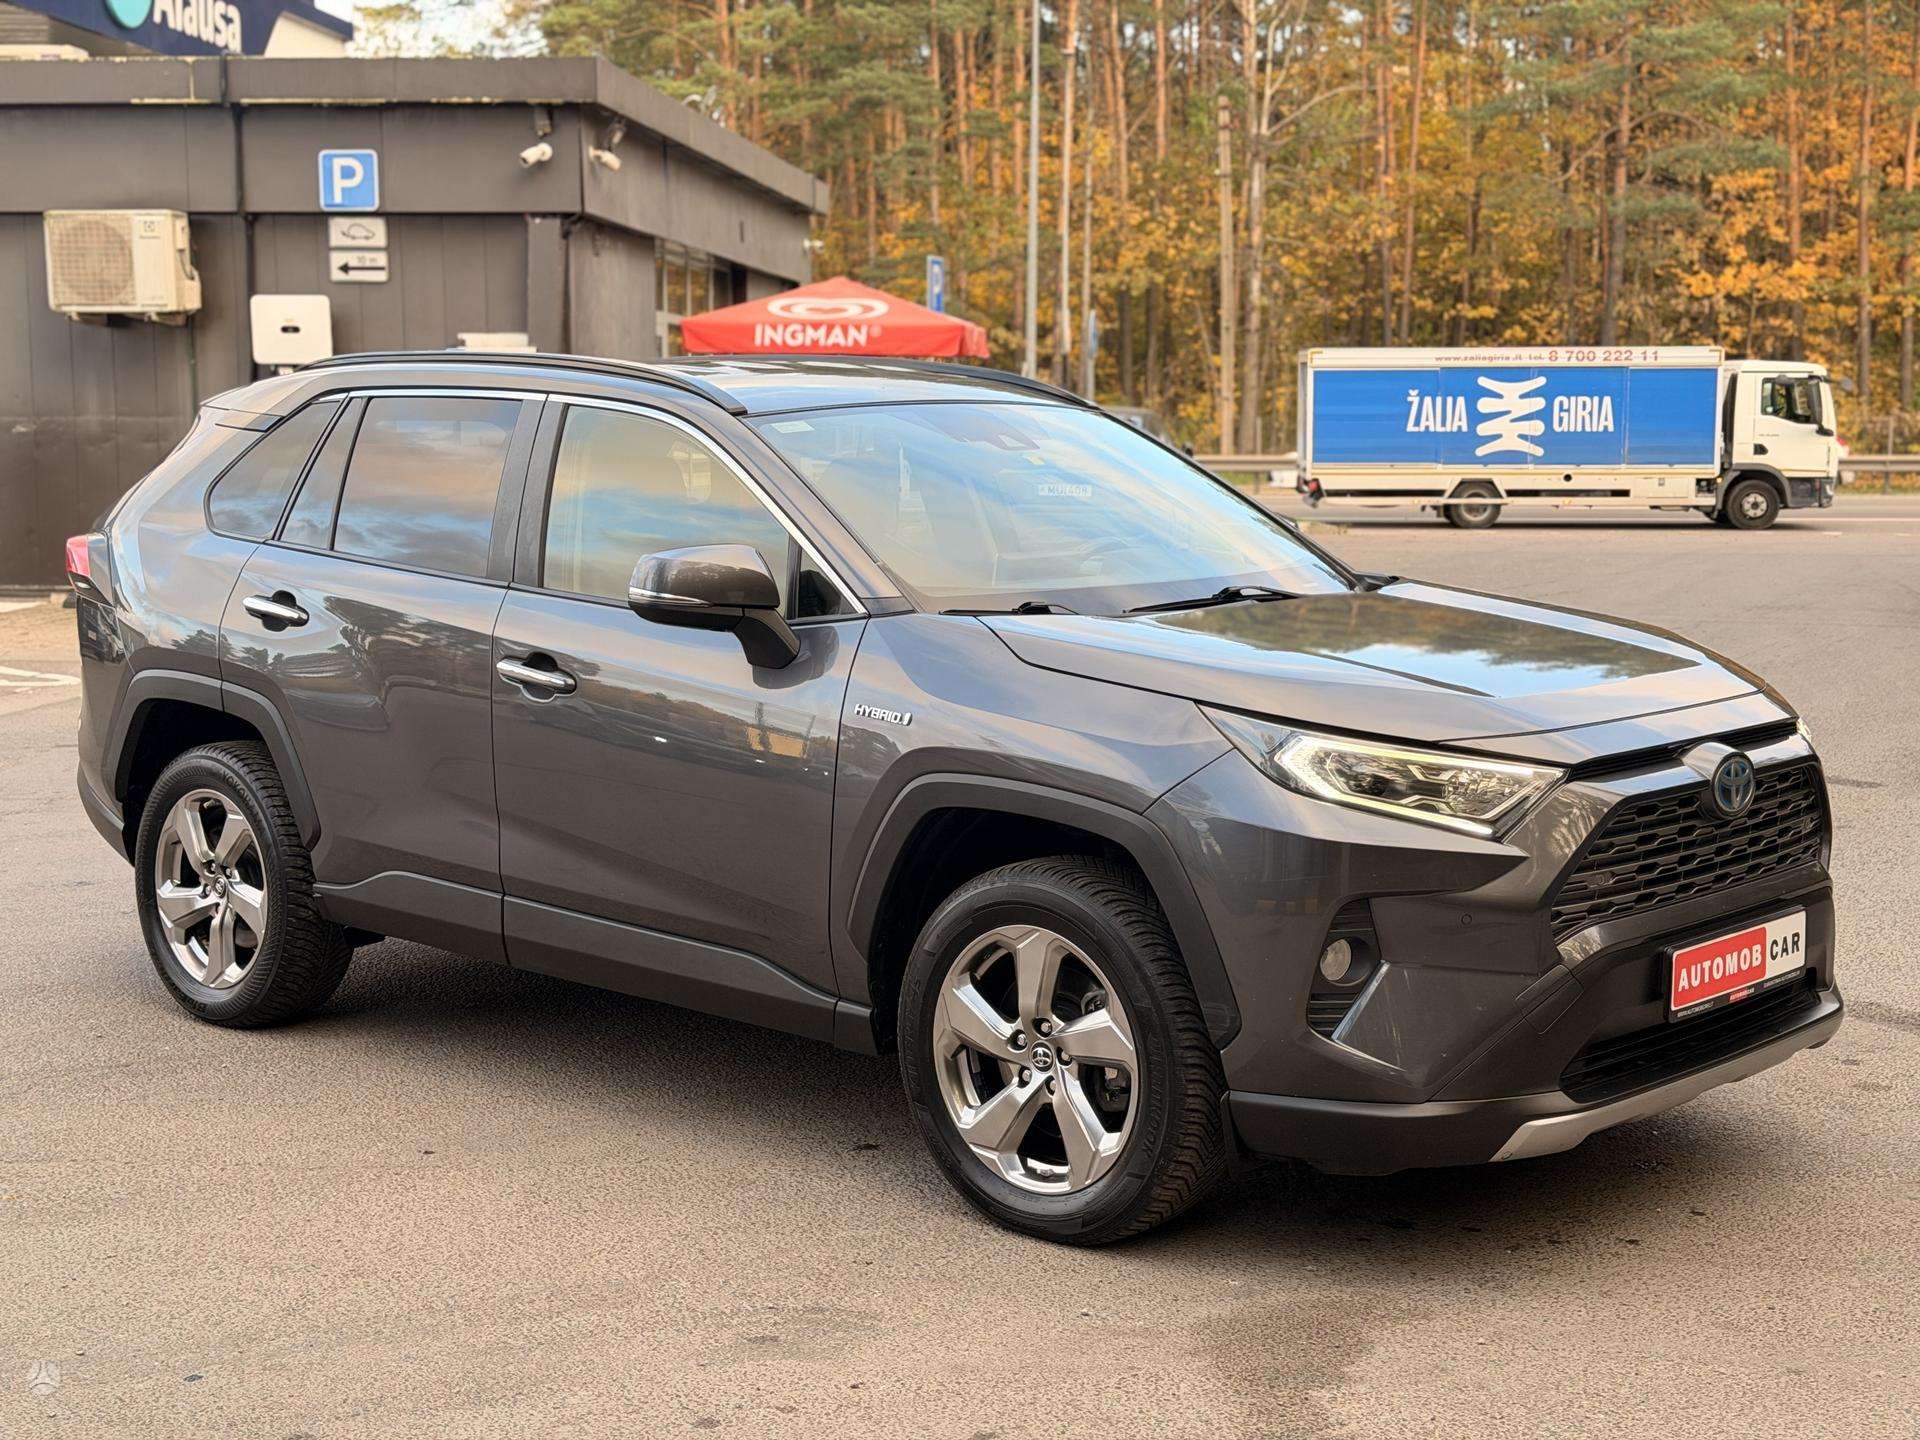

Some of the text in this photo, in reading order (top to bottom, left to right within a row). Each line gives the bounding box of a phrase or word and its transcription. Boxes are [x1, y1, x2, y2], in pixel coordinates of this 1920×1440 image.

[332, 157, 364, 203] P
[754, 323, 868, 346] INGMAN
[1548, 350, 1558, 361] 8
[1565, 350, 1596, 361] 700
[1603, 350, 1633, 361] 222
[1640, 350, 1658, 361] 11
[1406, 389, 1615, 432] ŽALIA GIRIA
[854, 703, 902, 724] HYBRID
[1678, 944, 1762, 992] AUTOMOB
[1769, 932, 1800, 961] CAR
